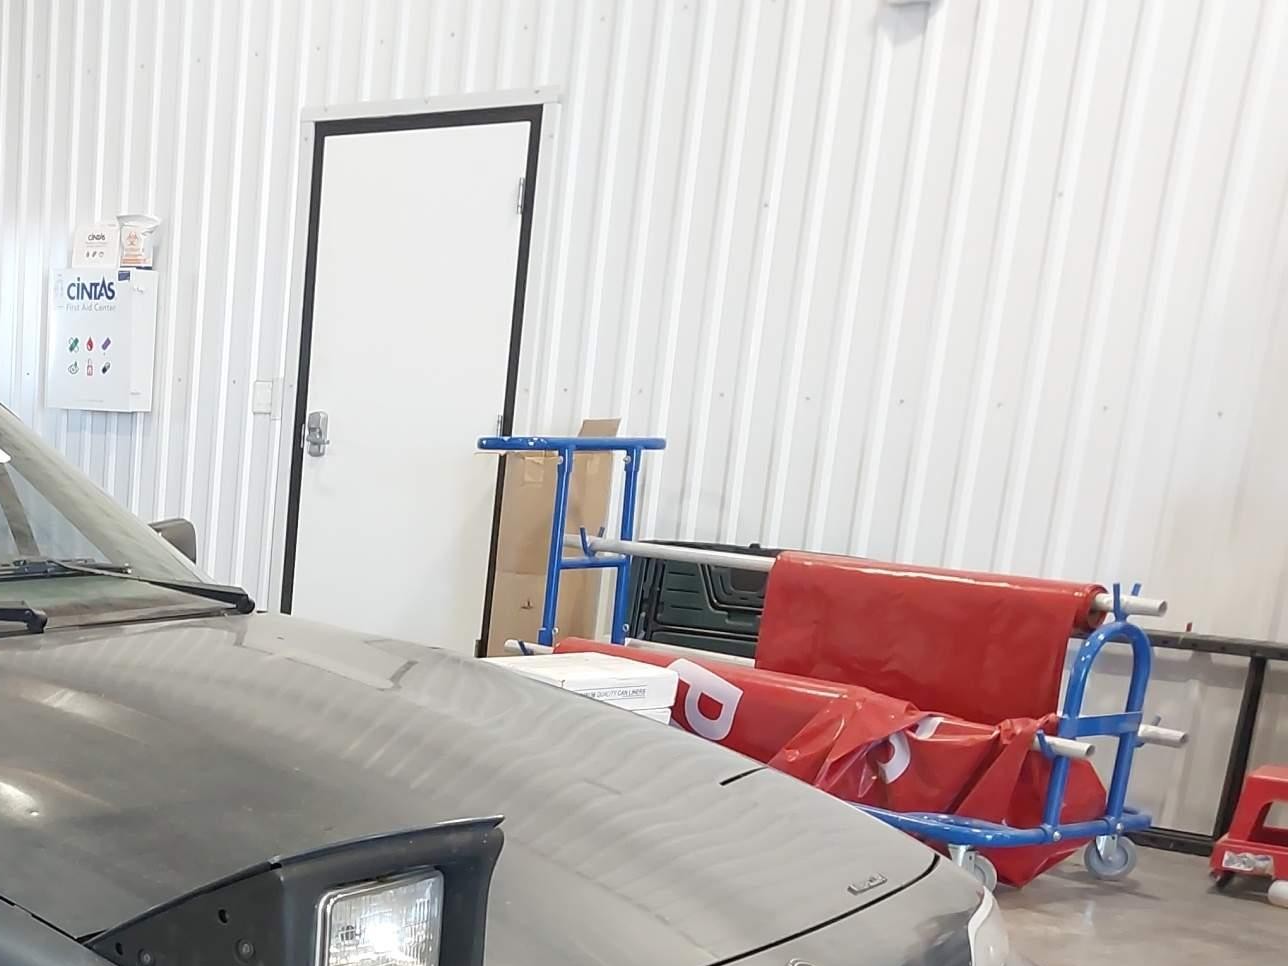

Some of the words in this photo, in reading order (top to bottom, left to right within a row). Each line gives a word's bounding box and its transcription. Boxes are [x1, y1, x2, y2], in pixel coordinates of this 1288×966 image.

[66, 275, 116, 301] CINTAS
[66, 303, 80, 311] First
[81, 303, 93, 311] Aid
[94, 302, 116, 311] Center
[617, 689, 628, 697] CAN
